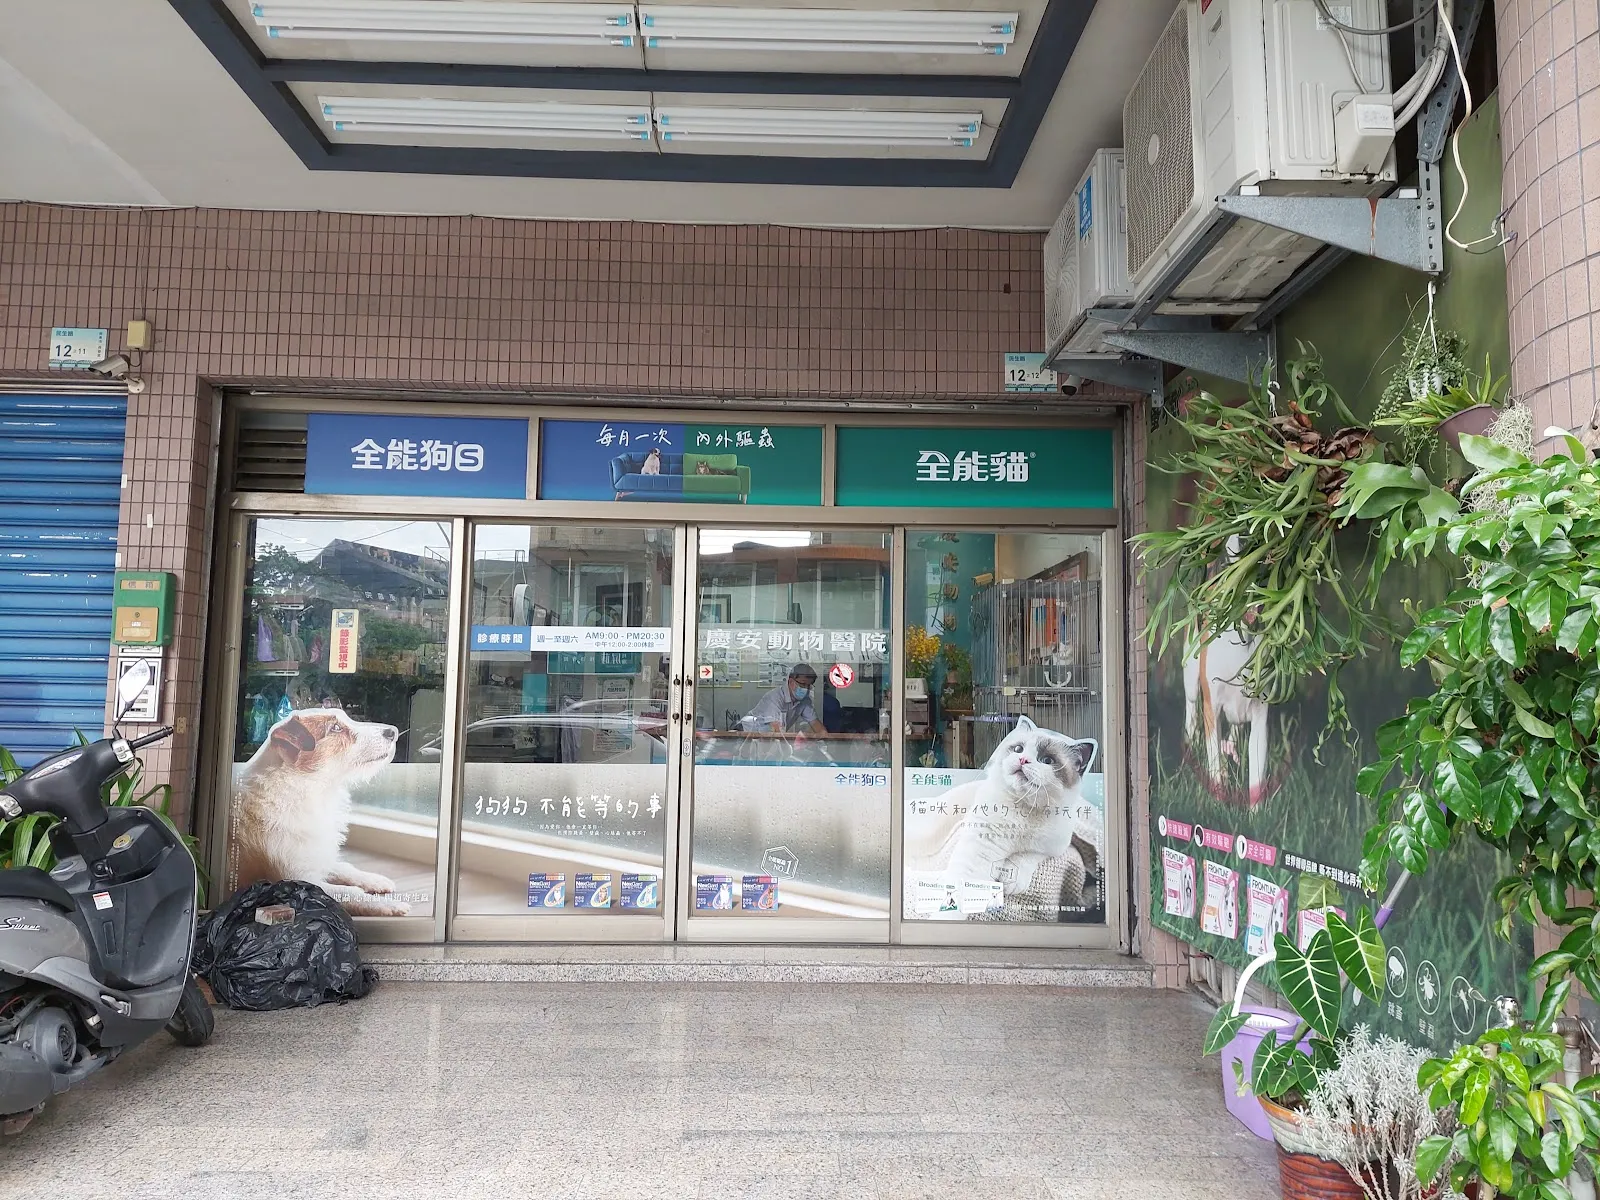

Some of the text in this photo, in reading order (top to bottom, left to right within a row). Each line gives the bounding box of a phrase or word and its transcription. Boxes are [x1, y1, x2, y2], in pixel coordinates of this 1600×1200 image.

[596, 424, 672, 446] 每月一次
[477, 632, 523, 644] 診療時間
[536, 634, 579, 644] 週一至週六
[585, 631, 619, 640] AM9:00
[626, 632, 665, 640] PM20:30
[704, 628, 888, 652] 慶安動物醫院
[911, 773, 953, 787] 全能貓
[474, 792, 663, 820] 狗狗 不能等的事
[1252, 879, 1276, 896] FRONTLINE
